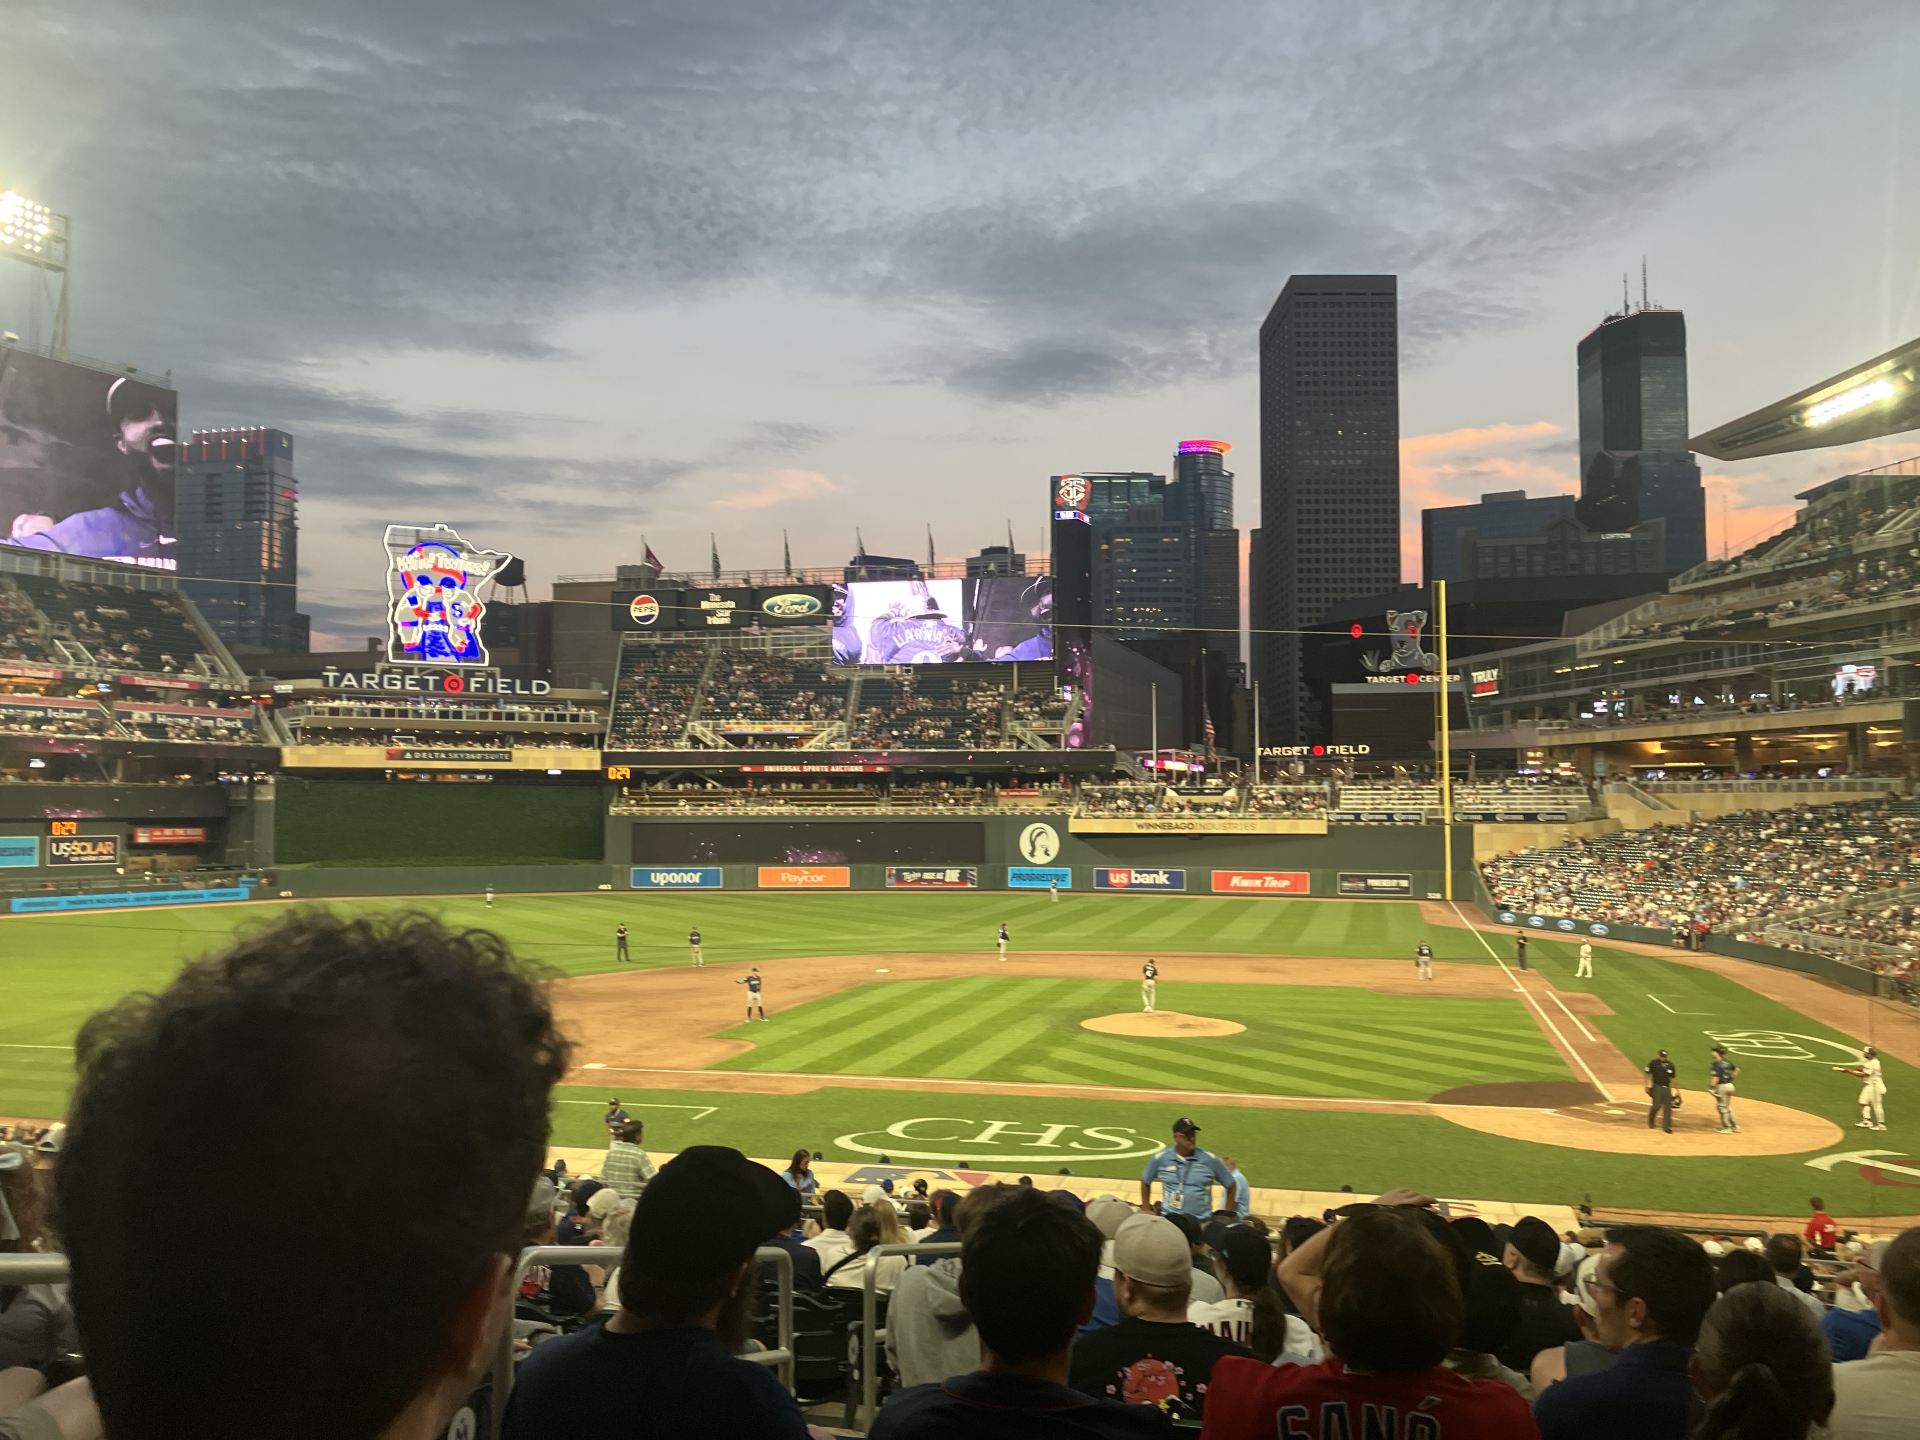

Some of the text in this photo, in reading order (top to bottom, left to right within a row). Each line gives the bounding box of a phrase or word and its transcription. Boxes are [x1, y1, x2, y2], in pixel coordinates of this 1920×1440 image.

[633, 605, 657, 613] PEPSI
[773, 599, 809, 615] Ford
[1364, 675, 1406, 684] TARGET
[1471, 668, 1499, 683] TRULY
[321, 671, 551, 695] TARGET FIELD
[413, 751, 447, 760] DELTA
[1257, 744, 1371, 757] TARGET FIELD
[763, 765, 864, 773] UNIVERSAL SPORTS AUCTIONS
[1135, 822, 1257, 832] WINNEBAGO INDUSTRIES
[650, 870, 702, 886] uponor
[780, 871, 827, 884] Paycor
[1130, 870, 1170, 886] bank
[1229, 875, 1291, 889] KWIK TRIP
[886, 1117, 1137, 1151] CHS
